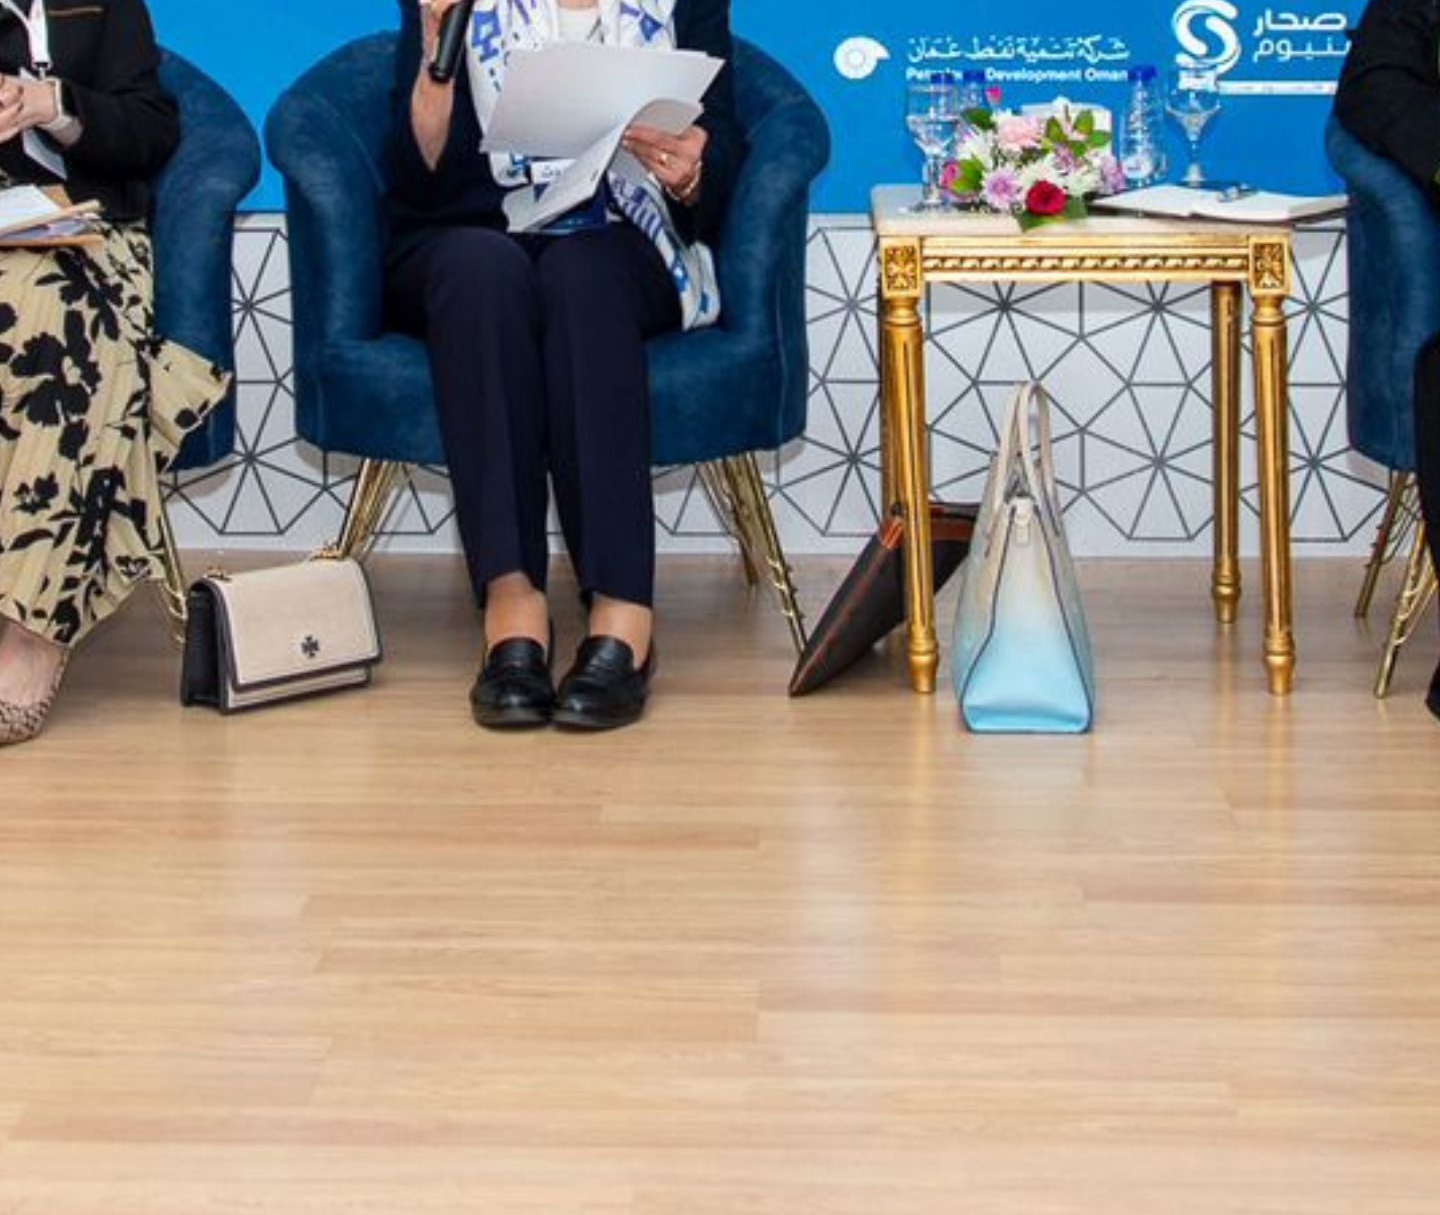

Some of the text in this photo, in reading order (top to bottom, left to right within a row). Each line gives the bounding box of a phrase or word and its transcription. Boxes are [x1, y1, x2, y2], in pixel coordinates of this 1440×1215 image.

[1252, 9, 1348, 37] صحار
[985, 66, 1081, 83] Development
[1085, 67, 1128, 81] Oman
